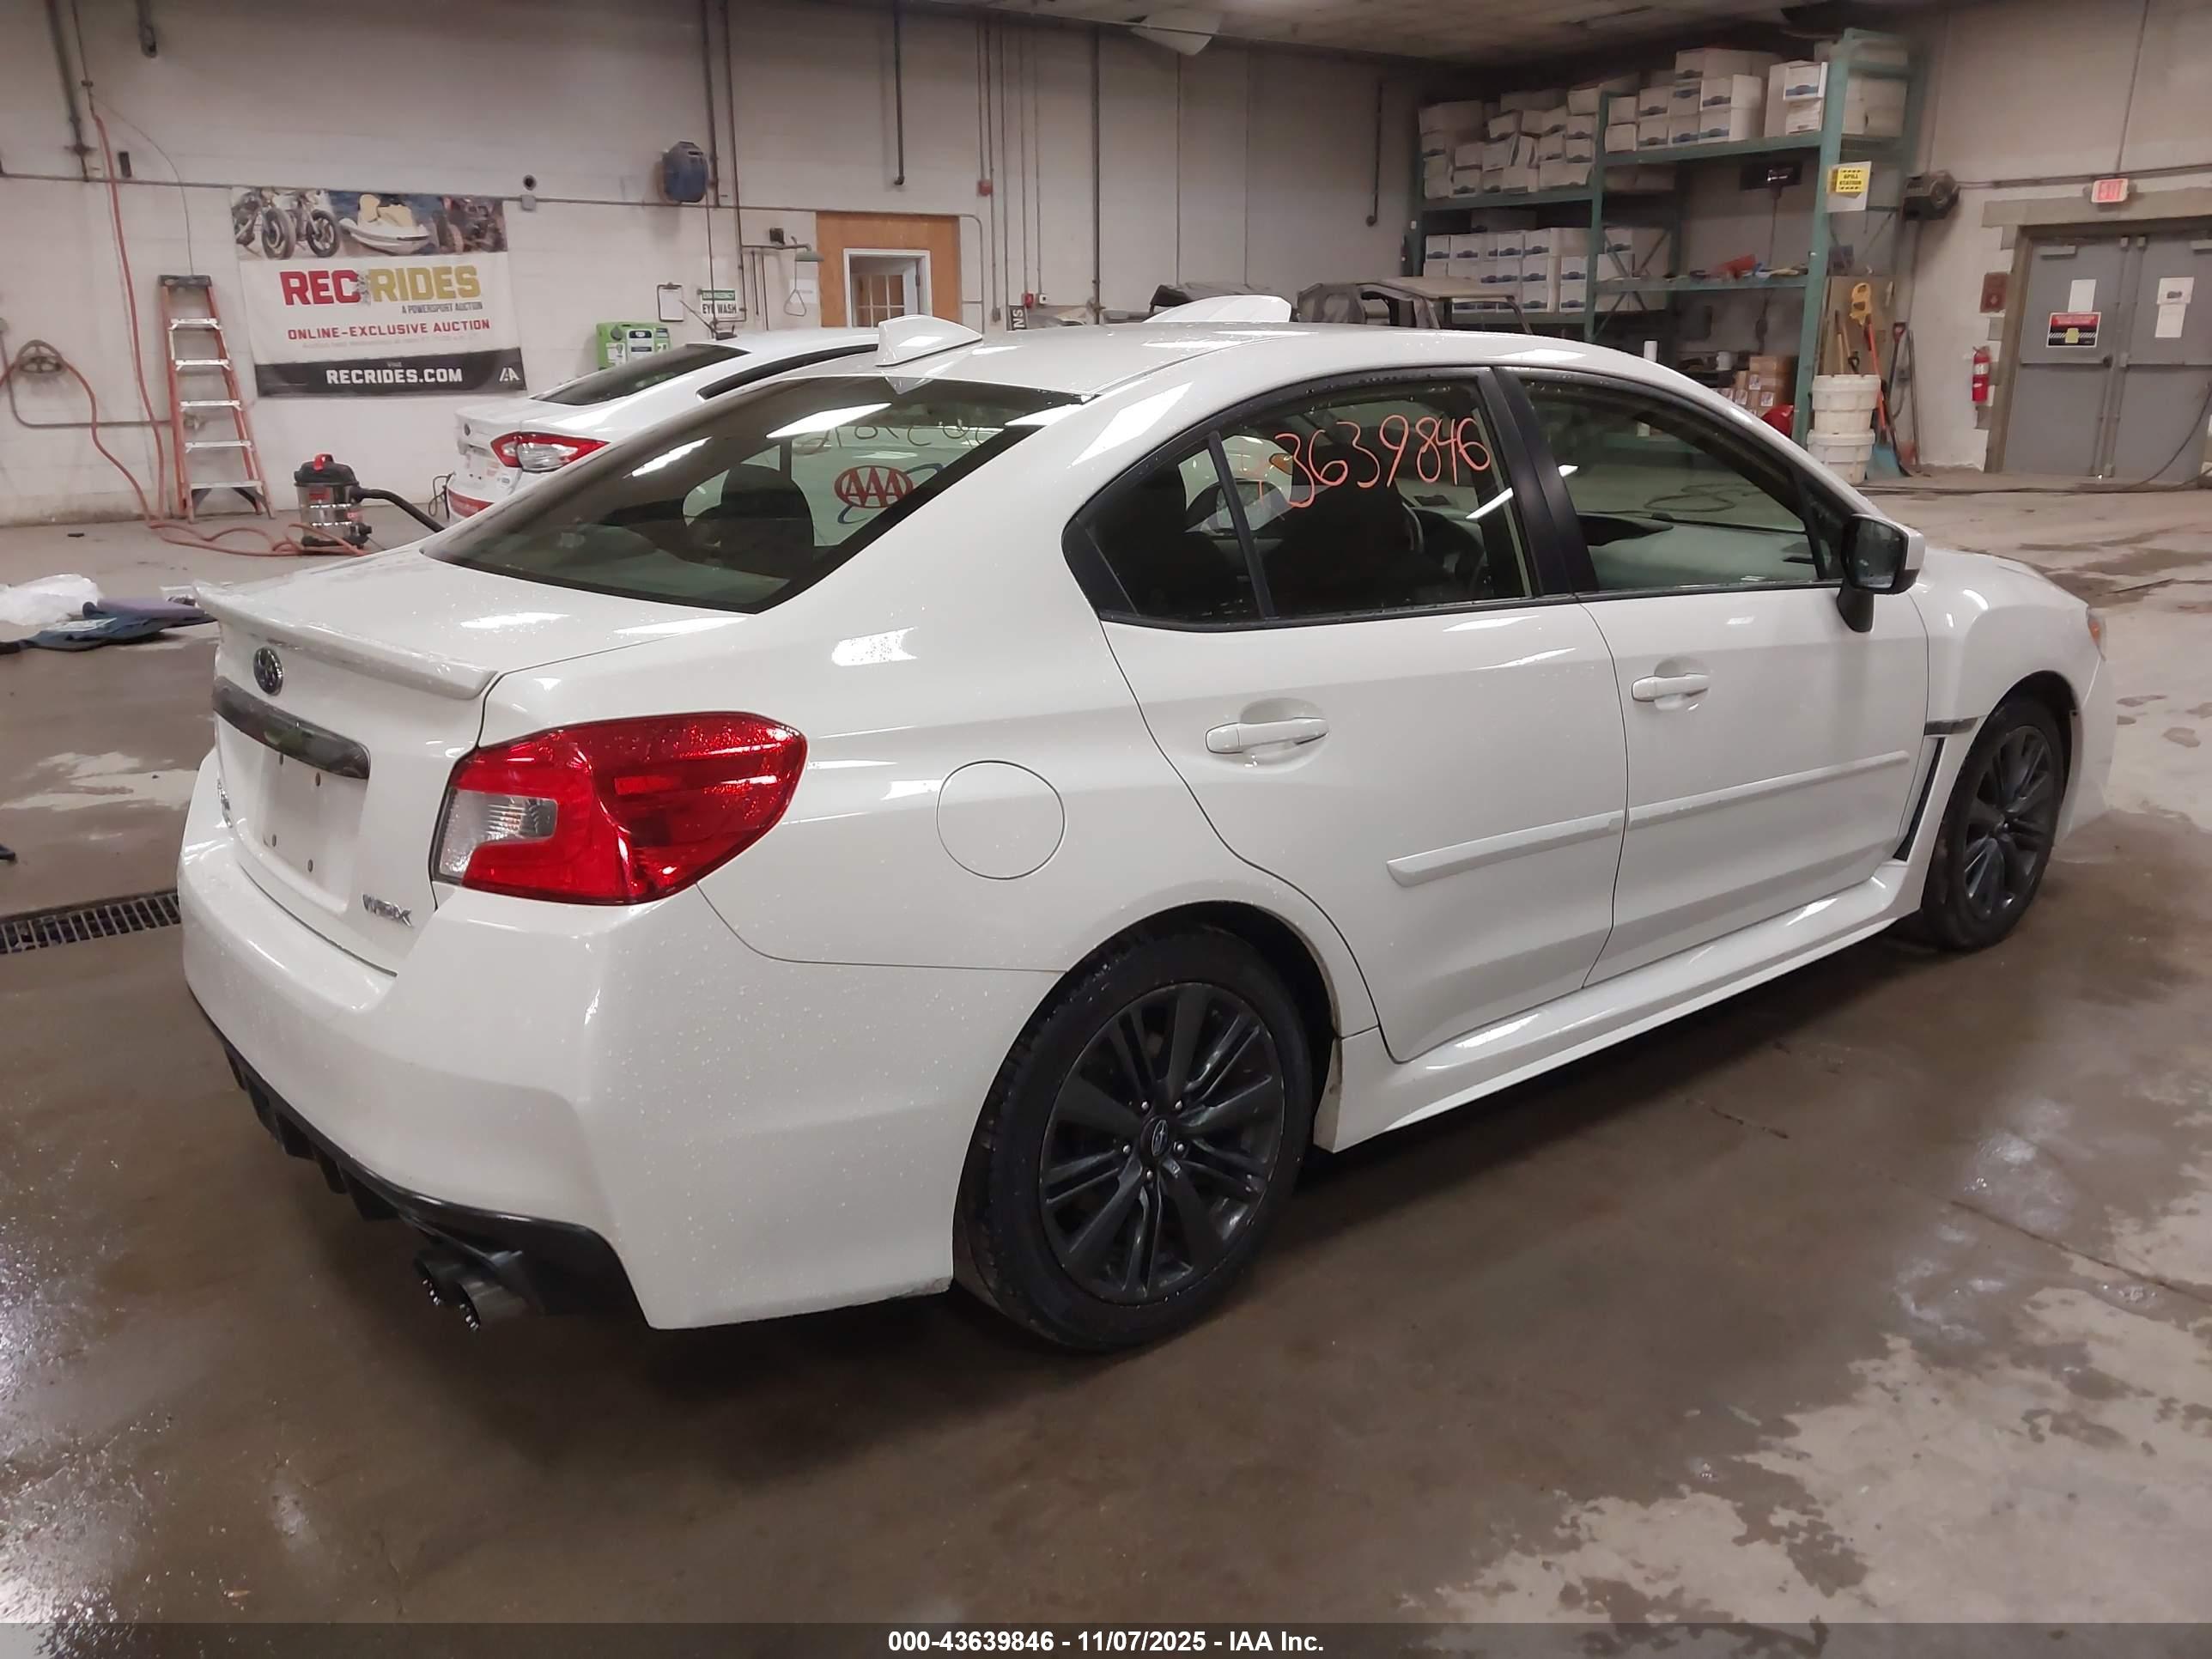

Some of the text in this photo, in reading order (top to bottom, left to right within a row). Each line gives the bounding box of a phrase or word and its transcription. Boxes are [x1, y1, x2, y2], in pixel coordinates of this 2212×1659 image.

[279, 264, 482, 306] REC RIDES
[408, 303, 453, 314] POWERSPORT
[455, 301, 483, 311] AUCTION
[716, 303, 737, 314] WASH
[288, 319, 490, 340] ONLINE-EXCLUSIVE AUCTION
[326, 368, 463, 385] RECRIDES.COM
[845, 467, 909, 507] AAA
